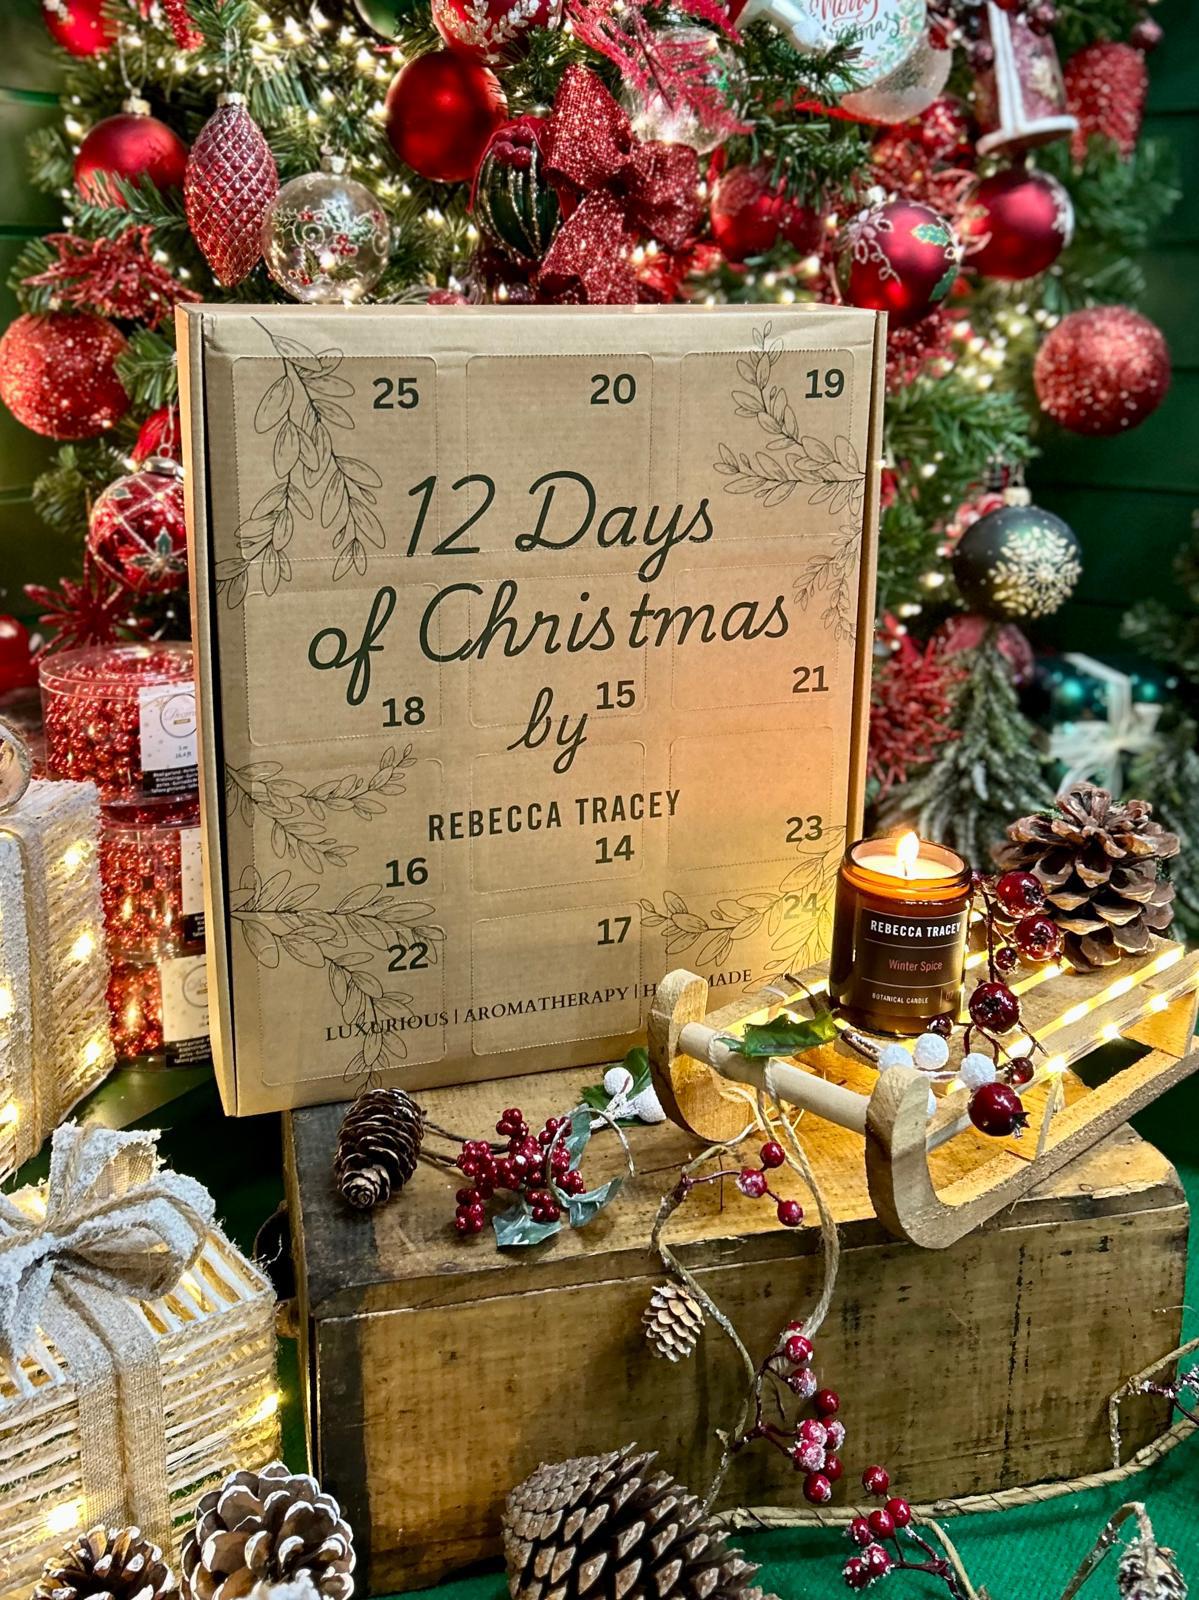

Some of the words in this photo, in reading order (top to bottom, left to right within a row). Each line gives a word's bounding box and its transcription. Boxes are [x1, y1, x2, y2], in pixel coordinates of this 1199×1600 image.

[373, 378, 419, 409] 25
[591, 374, 636, 404] 20
[805, 369, 845, 398] 19
[407, 474, 495, 557] 12
[515, 471, 713, 582] Days
[308, 586, 396, 705] of
[420, 579, 789, 663] Christmas
[597, 680, 635, 710] 15
[793, 666, 829, 694] 21
[383, 696, 425, 727] 18
[507, 687, 588, 774] by
[429, 801, 561, 841] REBECCA
[575, 789, 680, 825] TRACEY
[786, 815, 822, 843] 23
[596, 835, 634, 864] 14
[386, 858, 427, 888] 16
[783, 893, 819, 920] 24
[597, 917, 631, 945] 17
[870, 919, 923, 938] REBECCA
[387, 942, 428, 972] 22
[889, 959, 918, 971] Winter
[919, 960, 943, 972] Spice
[325, 1011, 449, 1041] LUXURIOUS
[463, 986, 629, 1023] AROMATHERAPY
[643, 969, 752, 998] HMADE
[872, 992, 904, 1004] BOTANICAL
